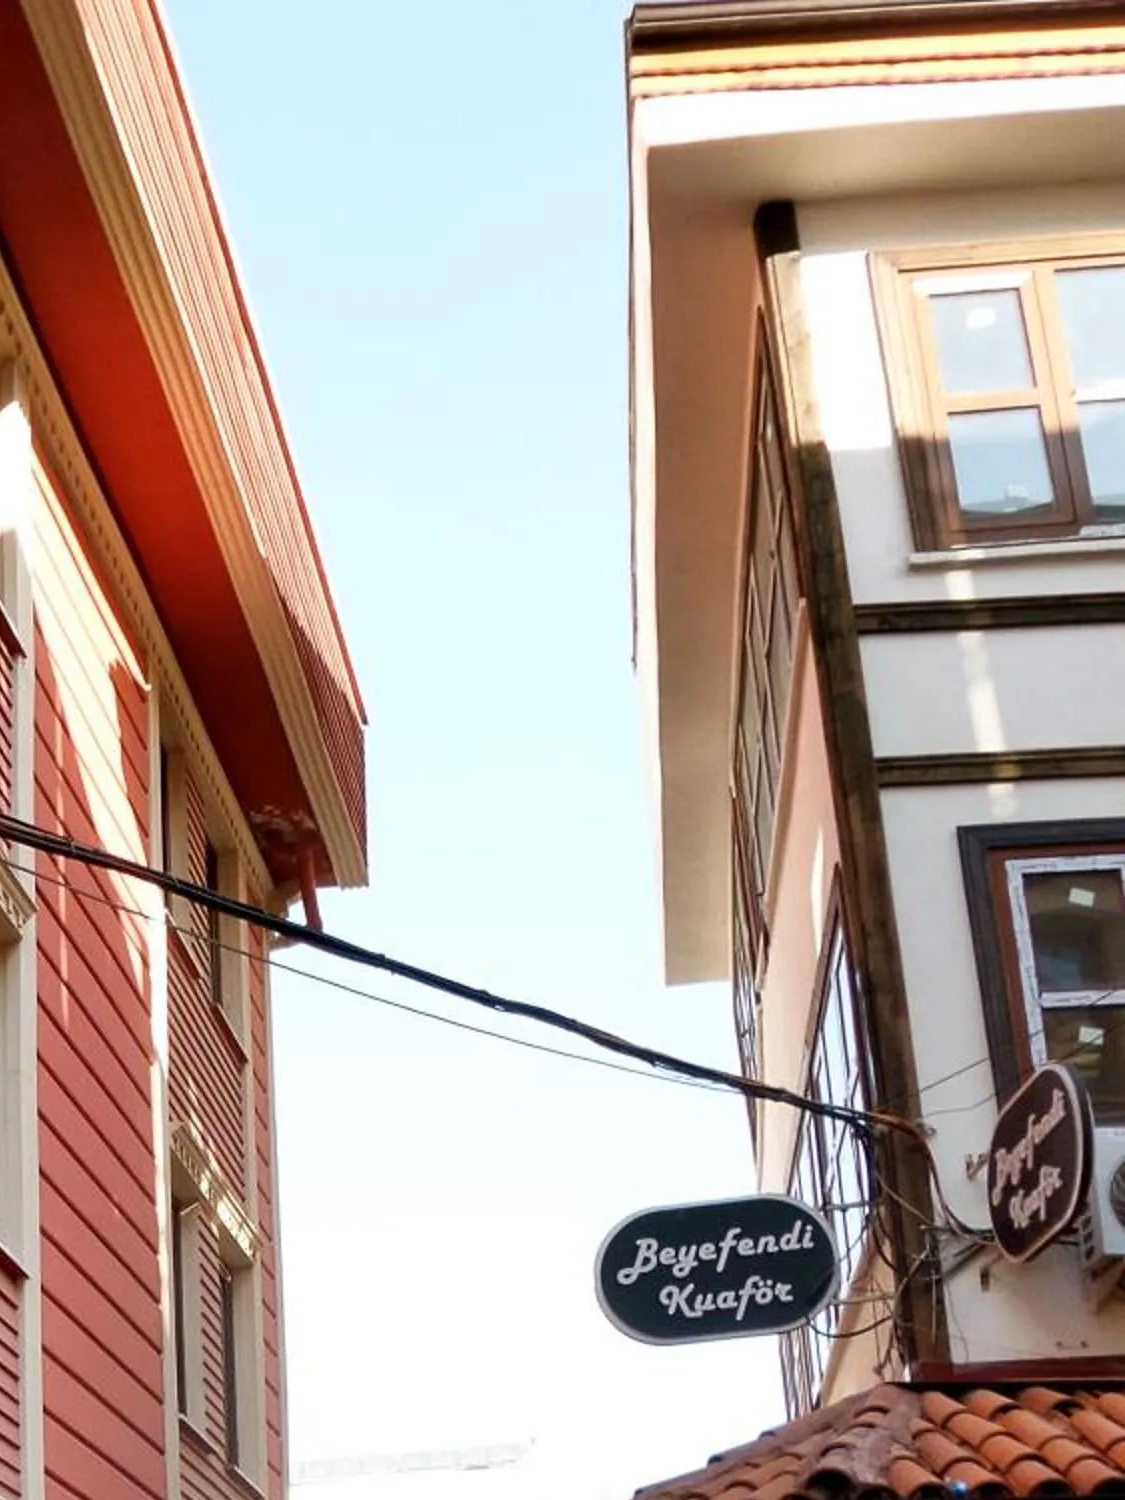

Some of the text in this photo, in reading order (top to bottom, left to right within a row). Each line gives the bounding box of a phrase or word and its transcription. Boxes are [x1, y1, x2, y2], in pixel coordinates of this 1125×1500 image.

[991, 1088, 1067, 1206] Beyefendi
[1009, 1165, 1063, 1229] Kuaför
[616, 1220, 814, 1284] Beyefendi
[659, 1275, 793, 1321] Kuaför
